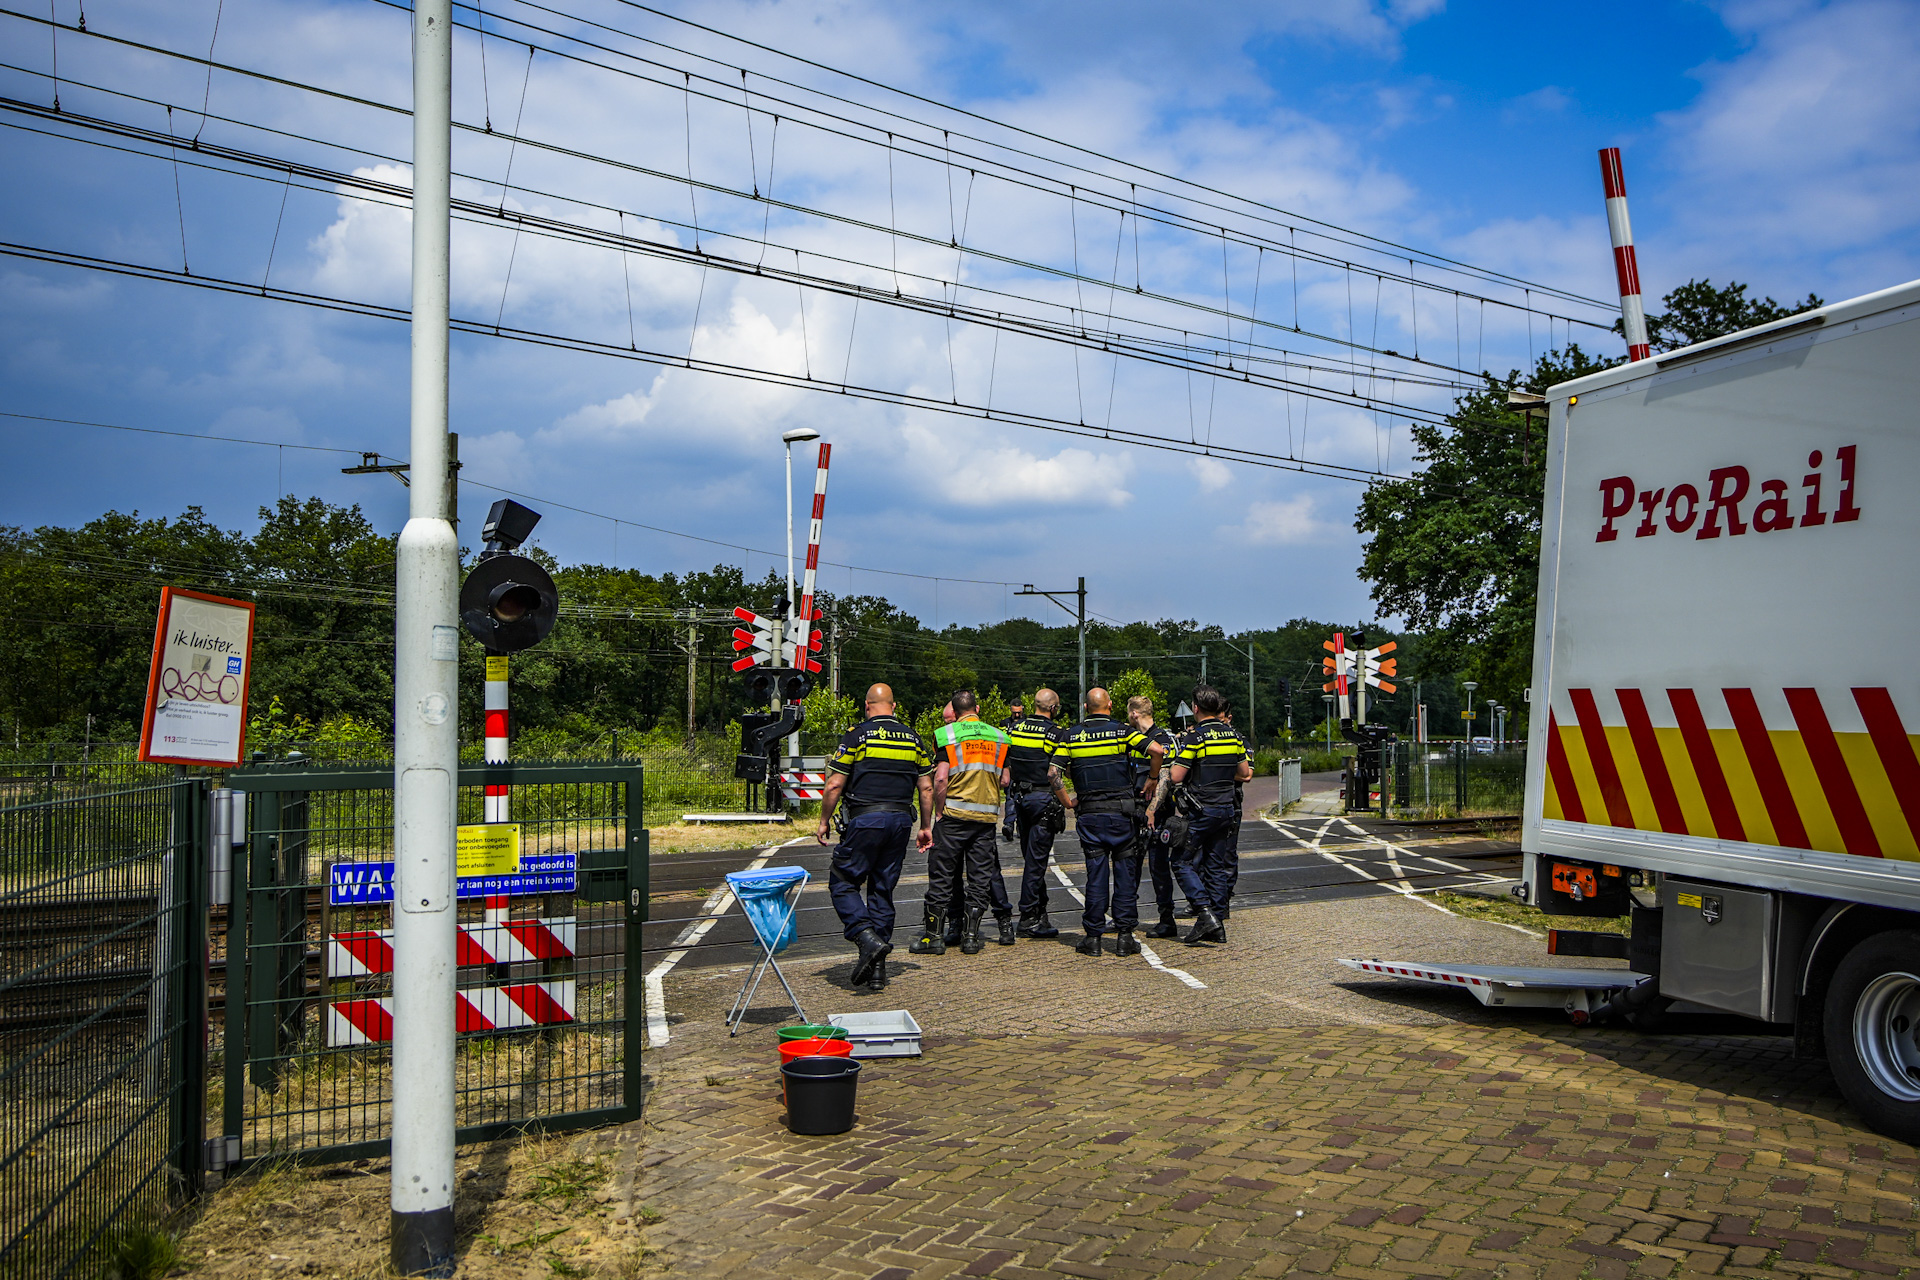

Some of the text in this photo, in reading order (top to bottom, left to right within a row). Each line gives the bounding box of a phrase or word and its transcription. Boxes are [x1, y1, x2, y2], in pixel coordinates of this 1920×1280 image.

[1595, 444, 1861, 543] ProRail
[173, 629, 240, 655] ik luister...
[873, 726, 910, 739] POLITIE
[1075, 729, 1110, 742] POLITIE
[1206, 729, 1235, 740] POLITIE
[164, 735, 176, 743] 113
[484, 836, 509, 844] toegang
[469, 843, 510, 851] onbevoegden
[530, 860, 565, 872] gedoofd
[567, 860, 574, 868] is
[467, 880, 482, 888] kan
[485, 880, 501, 889] nog
[504, 879, 520, 887] een
[522, 876, 543, 886] trein
[545, 875, 574, 885] komen
